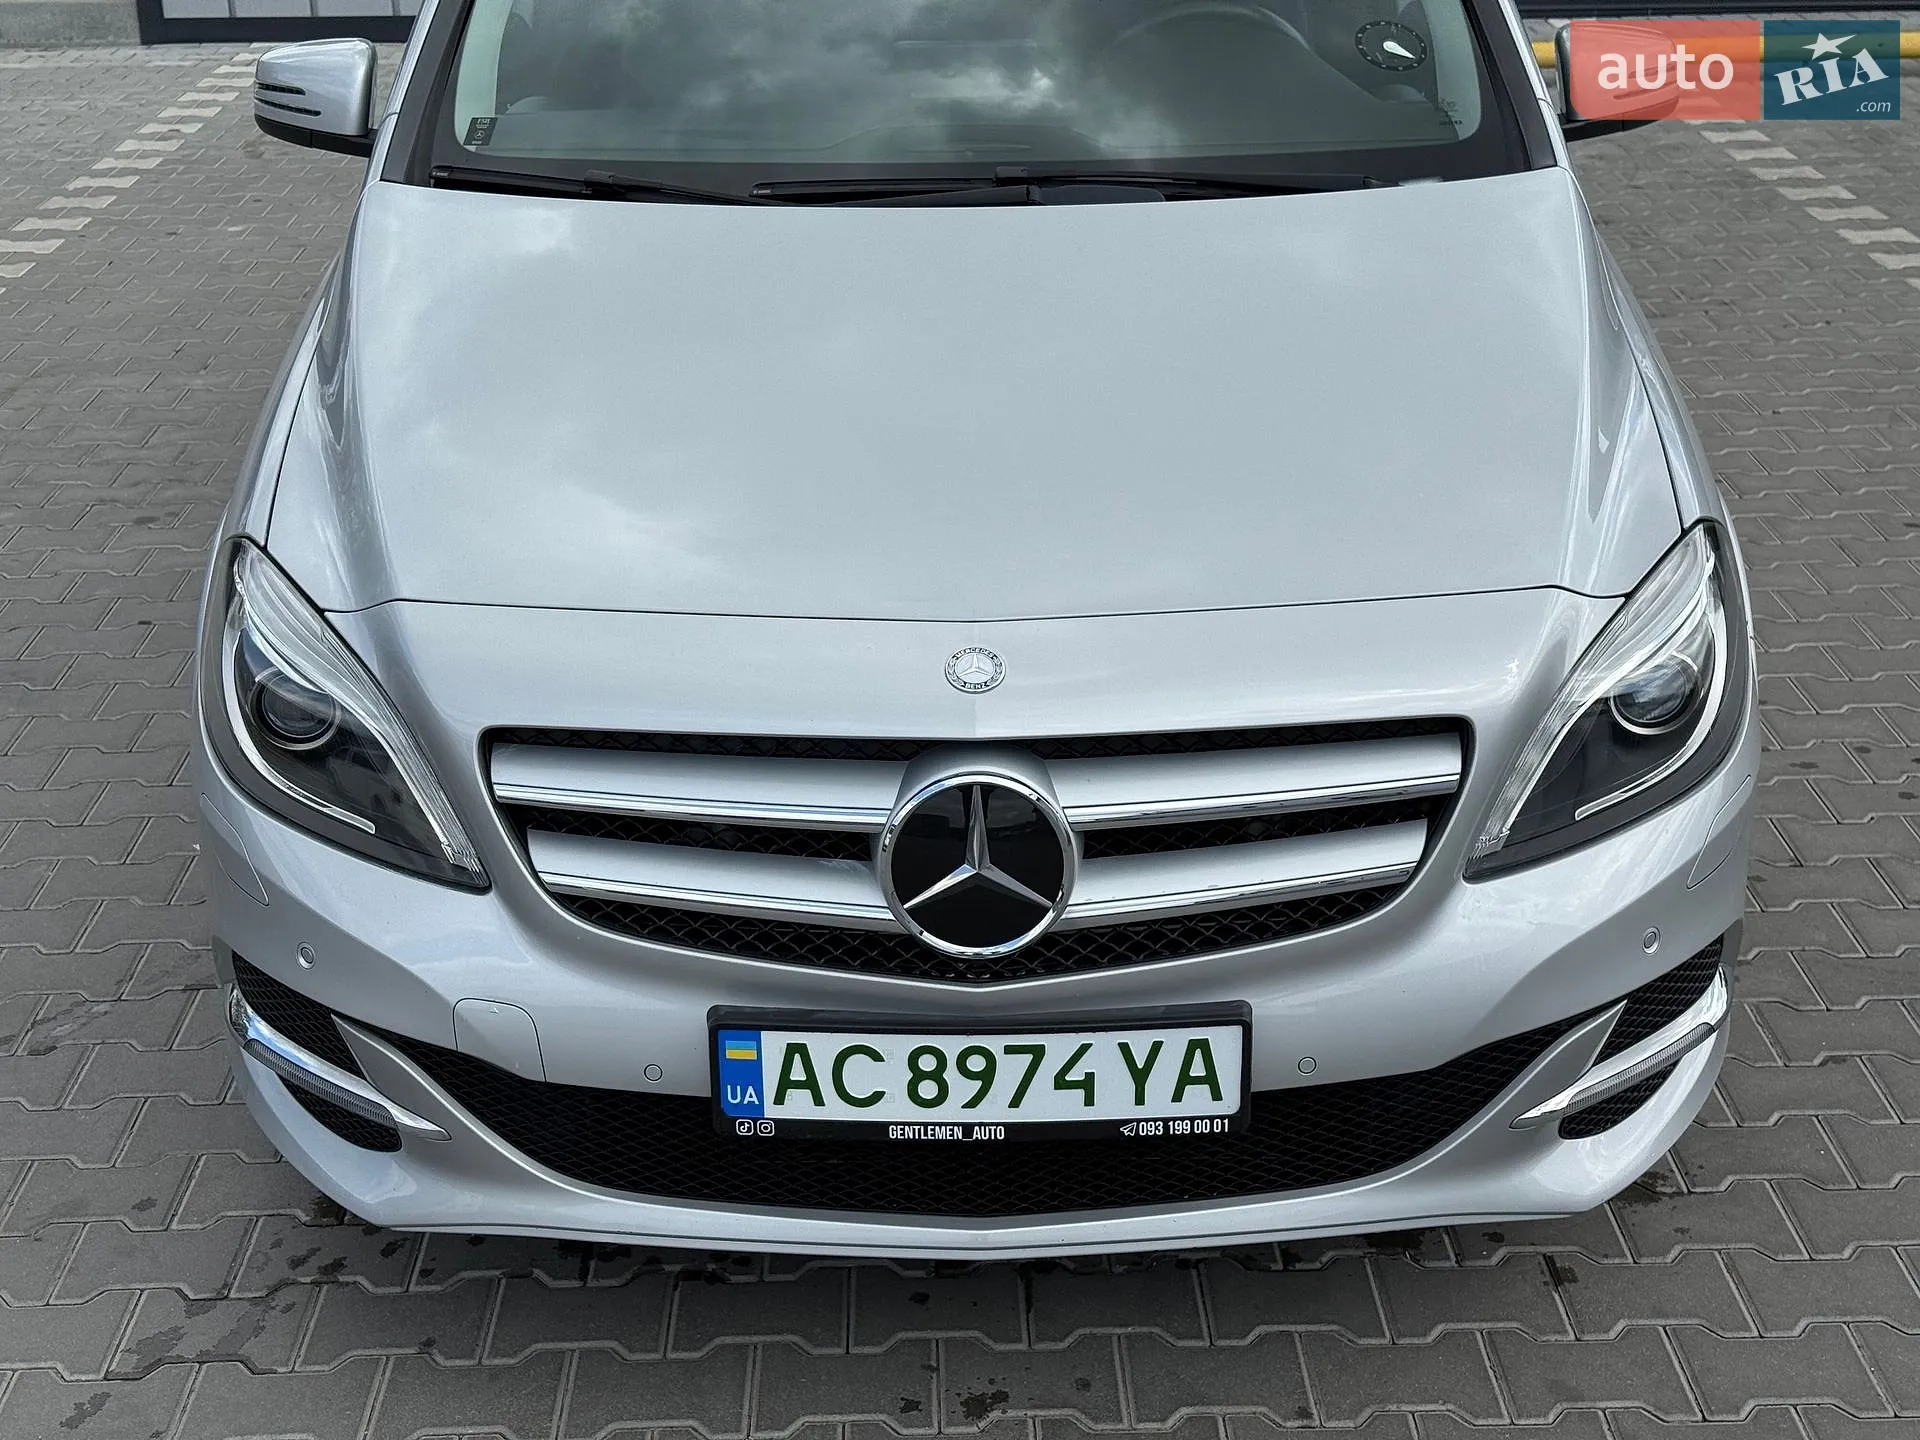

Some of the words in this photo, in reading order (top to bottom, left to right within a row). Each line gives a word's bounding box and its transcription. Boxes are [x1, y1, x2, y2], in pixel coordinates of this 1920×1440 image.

[773, 1041, 887, 1109] AC
[906, 1042, 1097, 1110] 8974
[1117, 1037, 1224, 1106] YA
[727, 1084, 760, 1105] UA
[888, 1124, 1005, 1141] GENTLEMEN_AUTO
[1139, 1121, 1164, 1136] 093
[1167, 1120, 1191, 1135] 199
[1194, 1119, 1210, 1134] 00
[1213, 1118, 1229, 1133] 01
